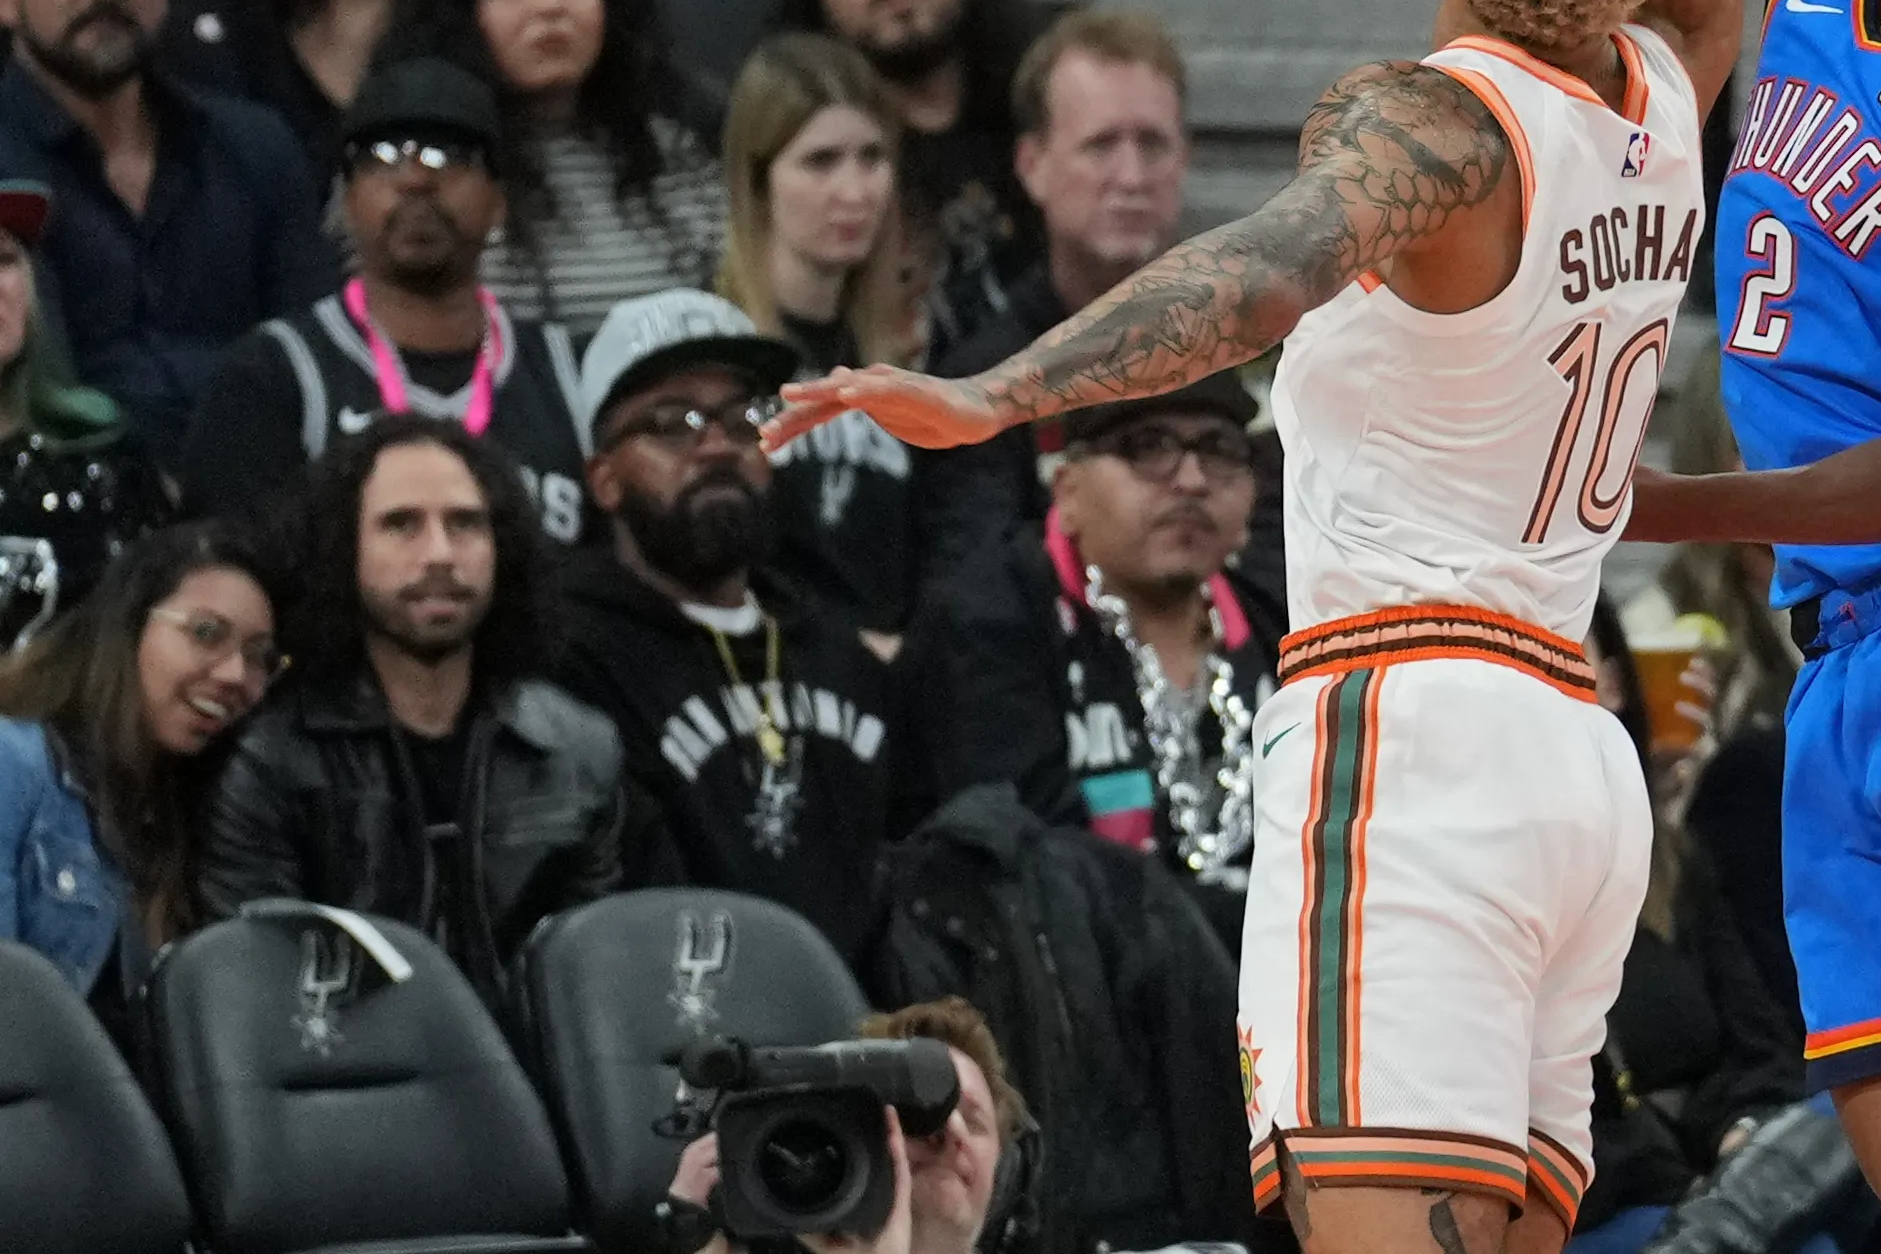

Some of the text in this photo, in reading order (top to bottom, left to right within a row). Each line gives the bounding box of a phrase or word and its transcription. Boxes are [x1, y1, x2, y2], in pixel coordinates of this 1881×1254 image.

[1559, 204, 1698, 304] SOCHA
[1727, 211, 1797, 358] 2
[1520, 318, 1669, 544] 10
